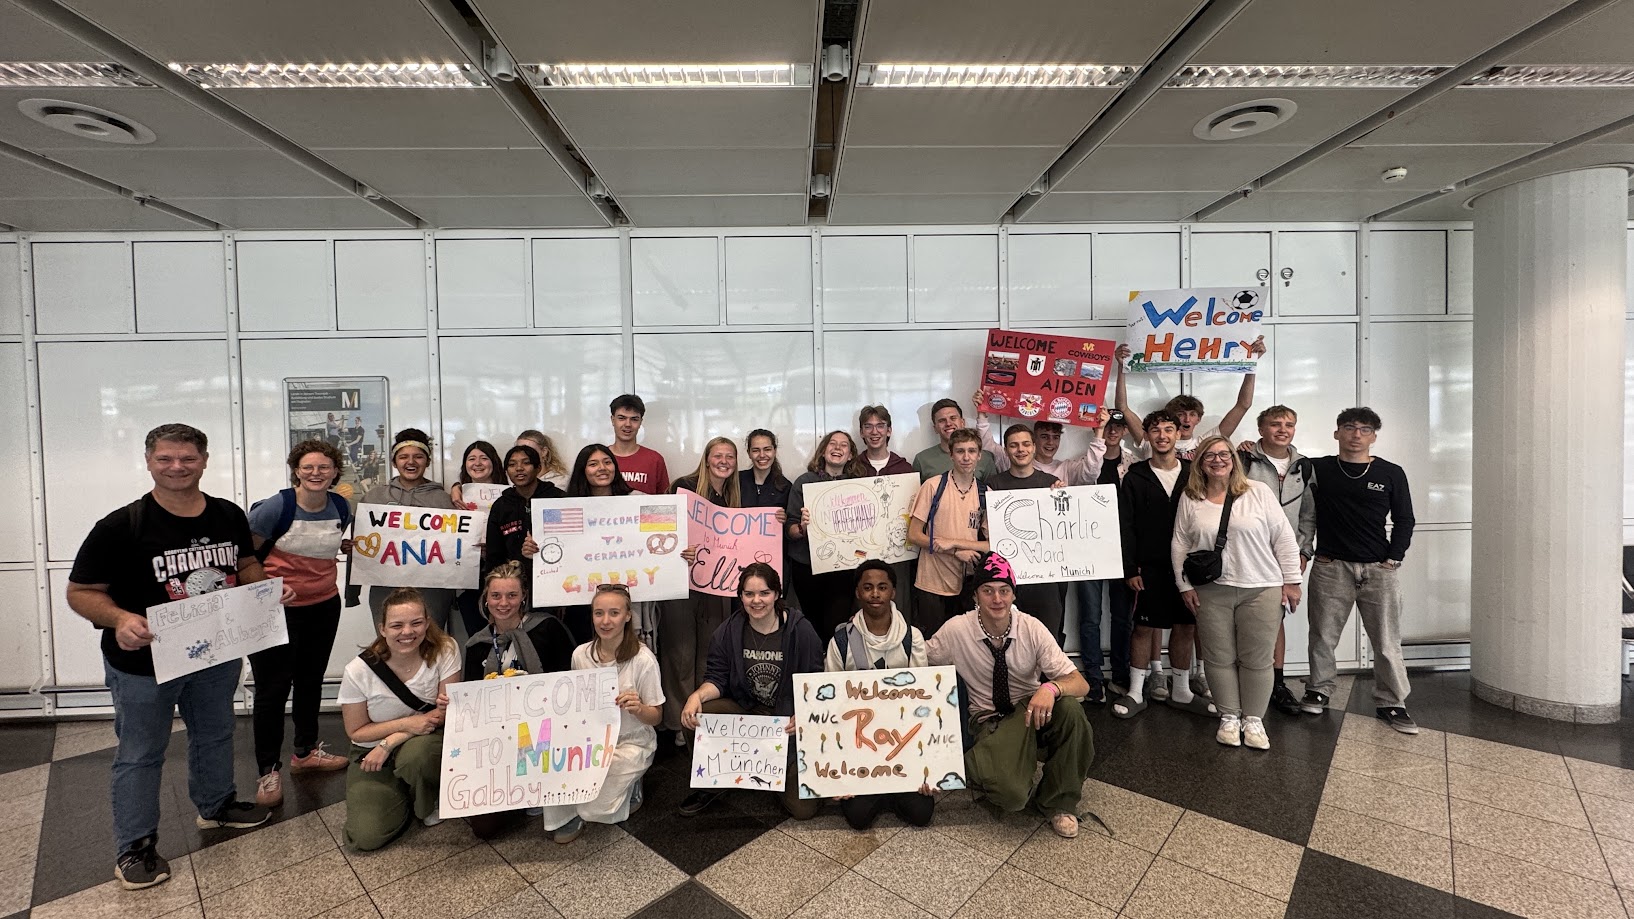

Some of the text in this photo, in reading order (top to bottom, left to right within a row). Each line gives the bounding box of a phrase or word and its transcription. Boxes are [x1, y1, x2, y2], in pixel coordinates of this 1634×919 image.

[990, 333, 1057, 354] WELCOME
[1067, 350, 1111, 361] COWBOYS
[1040, 378, 1096, 396] AIDEN
[341, 391, 358, 408] M
[1367, 481, 1385, 490] EA7
[369, 510, 472, 533] WELCOME
[587, 515, 640, 527] WELCOME
[1004, 498, 1101, 540] Charlie
[601, 536, 623, 545] TO
[703, 531, 738, 551] to Munich
[584, 549, 644, 562] GERMANY
[1021, 541, 1065, 564] Ward
[152, 544, 239, 582] CHAMPIONS
[1061, 564, 1096, 577] Munich!
[169, 577, 181, 587] 20
[562, 566, 660, 593] GABBY
[172, 586, 185, 596] 25
[155, 594, 224, 626] Felicia
[225, 613, 235, 625] &
[215, 614, 280, 650] Albert
[751, 663, 779, 675] JOHNNY
[845, 679, 933, 700] Welcome
[452, 672, 617, 733] WELCOME
[809, 710, 839, 724] MUC
[705, 717, 783, 738] Welcome
[841, 708, 923, 761] Ray
[516, 718, 614, 777] Munich
[731, 739, 751, 753] to
[927, 733, 956, 747] MUC
[468, 736, 504, 769] TO
[815, 761, 908, 779] Welcome
[447, 765, 542, 811] Gabby
